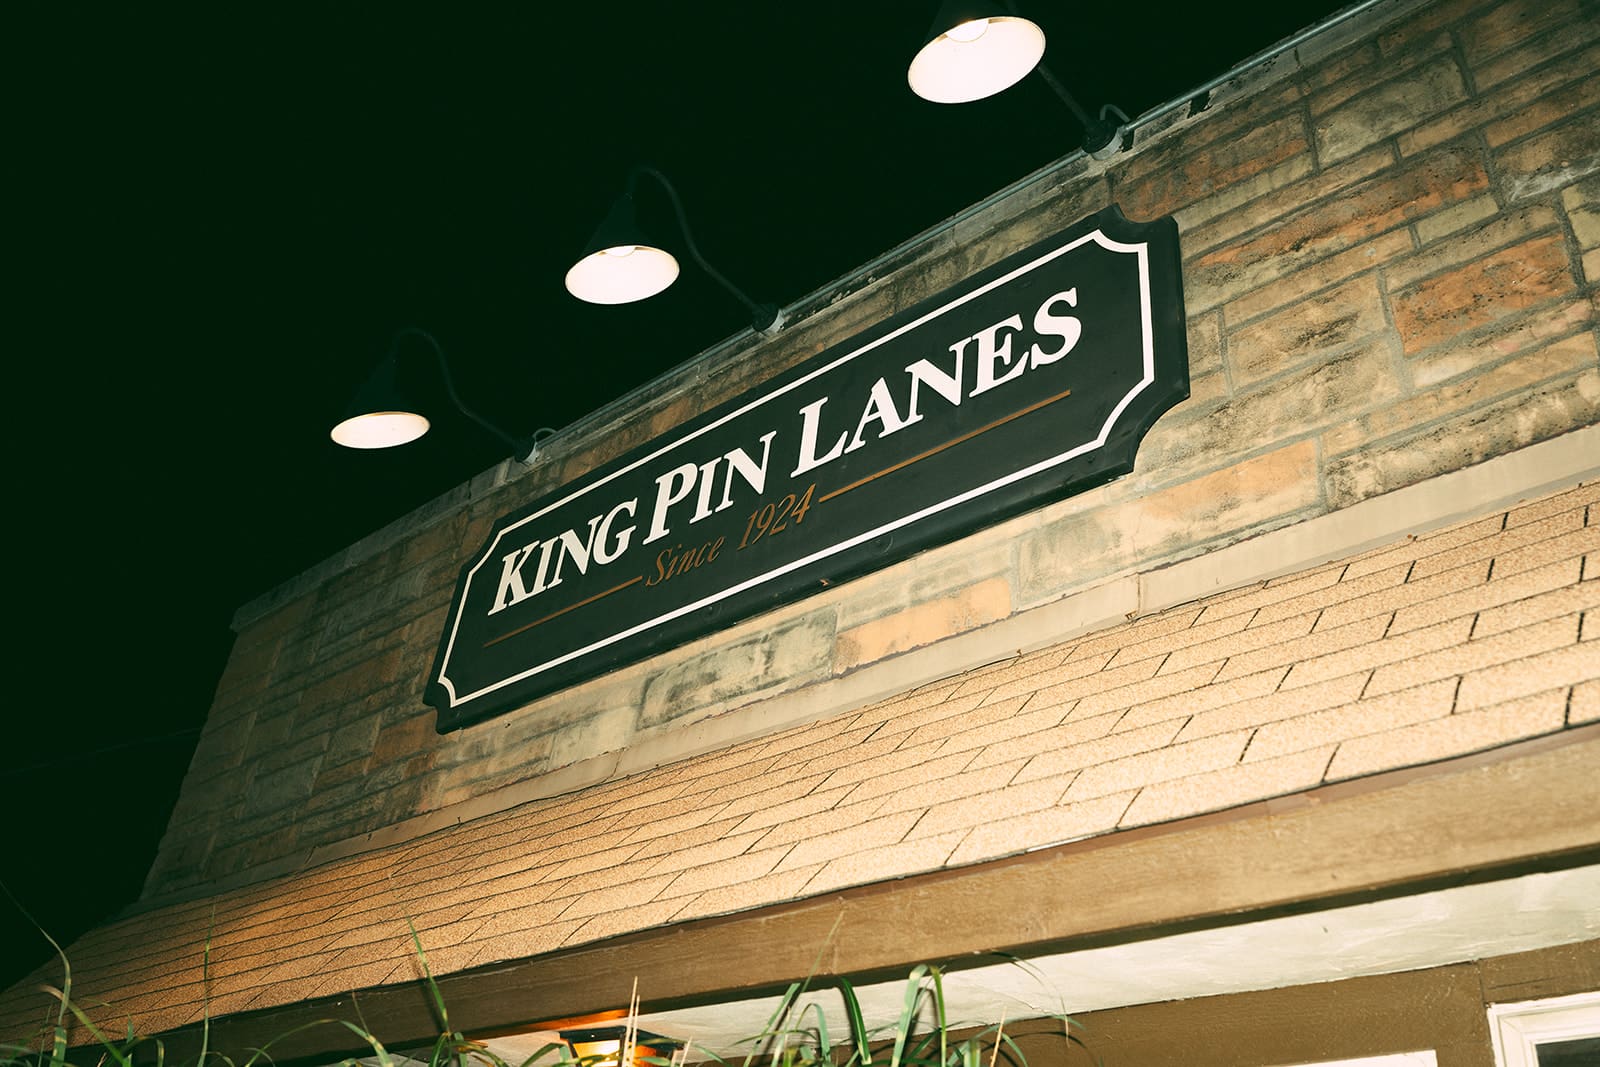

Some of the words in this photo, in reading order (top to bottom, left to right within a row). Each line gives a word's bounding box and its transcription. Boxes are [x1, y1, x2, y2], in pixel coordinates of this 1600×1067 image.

[488, 496, 638, 616] KING
[643, 430, 777, 545] PIN
[790, 287, 1083, 478] LANES
[645, 534, 726, 588] Since
[737, 483, 817, 552] 1924
